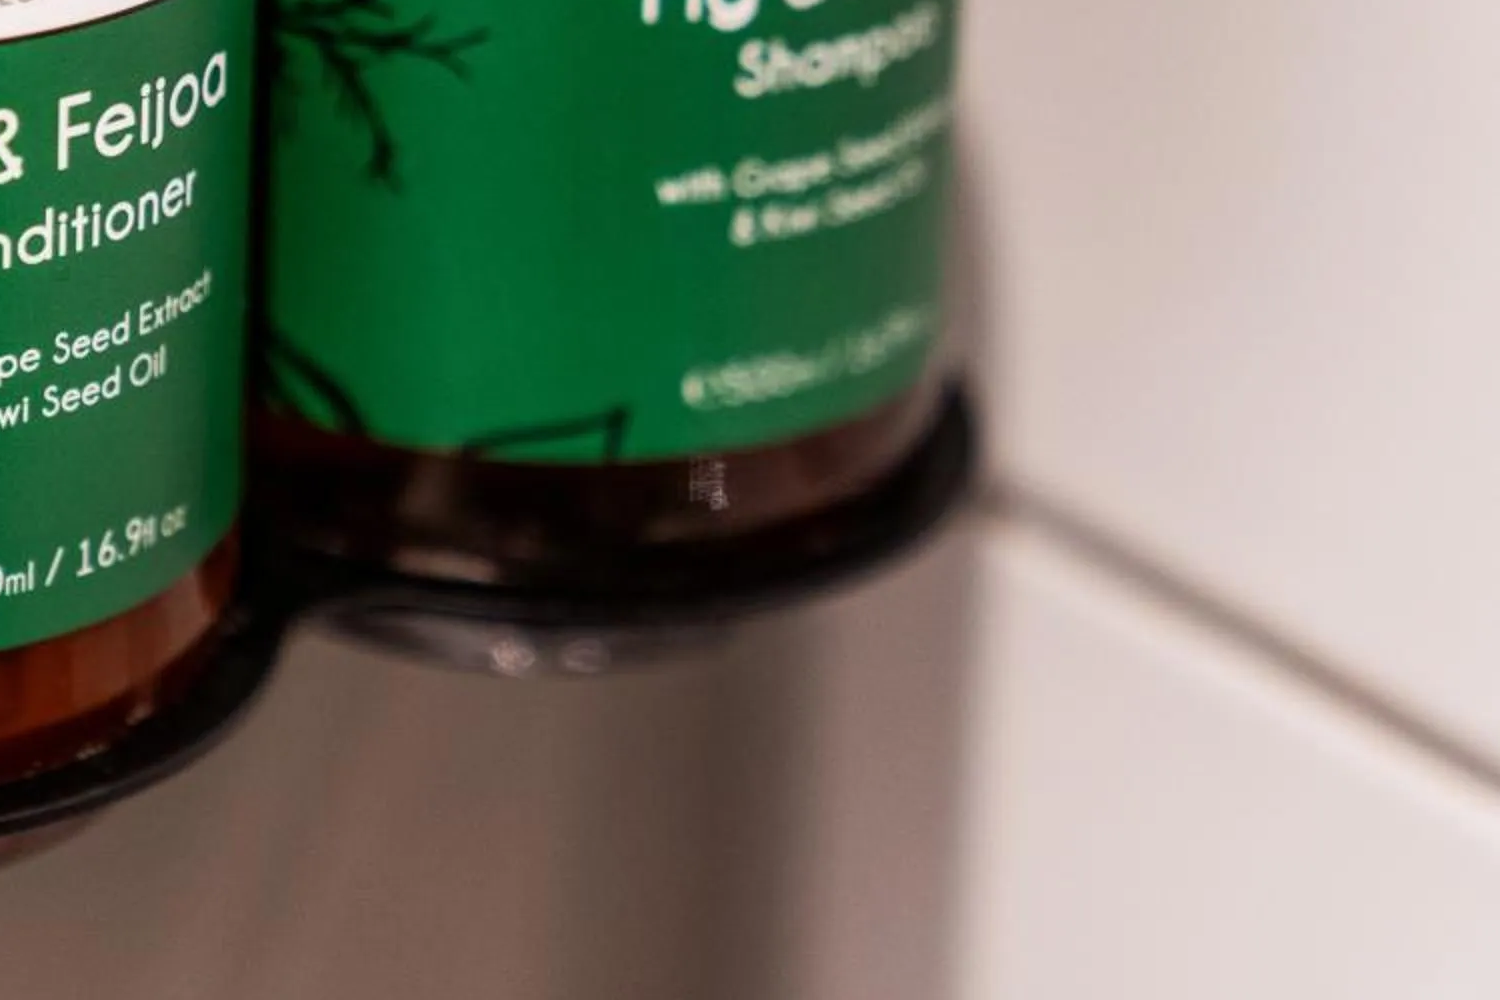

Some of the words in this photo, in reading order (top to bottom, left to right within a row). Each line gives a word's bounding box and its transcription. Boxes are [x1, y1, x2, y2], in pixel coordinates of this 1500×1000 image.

[56, 50, 228, 171] Feijoa
[52, 311, 130, 365] Seed
[138, 268, 213, 336] Extract
[41, 365, 121, 418] Seed
[128, 344, 166, 388] Oil
[44, 546, 65, 587] /
